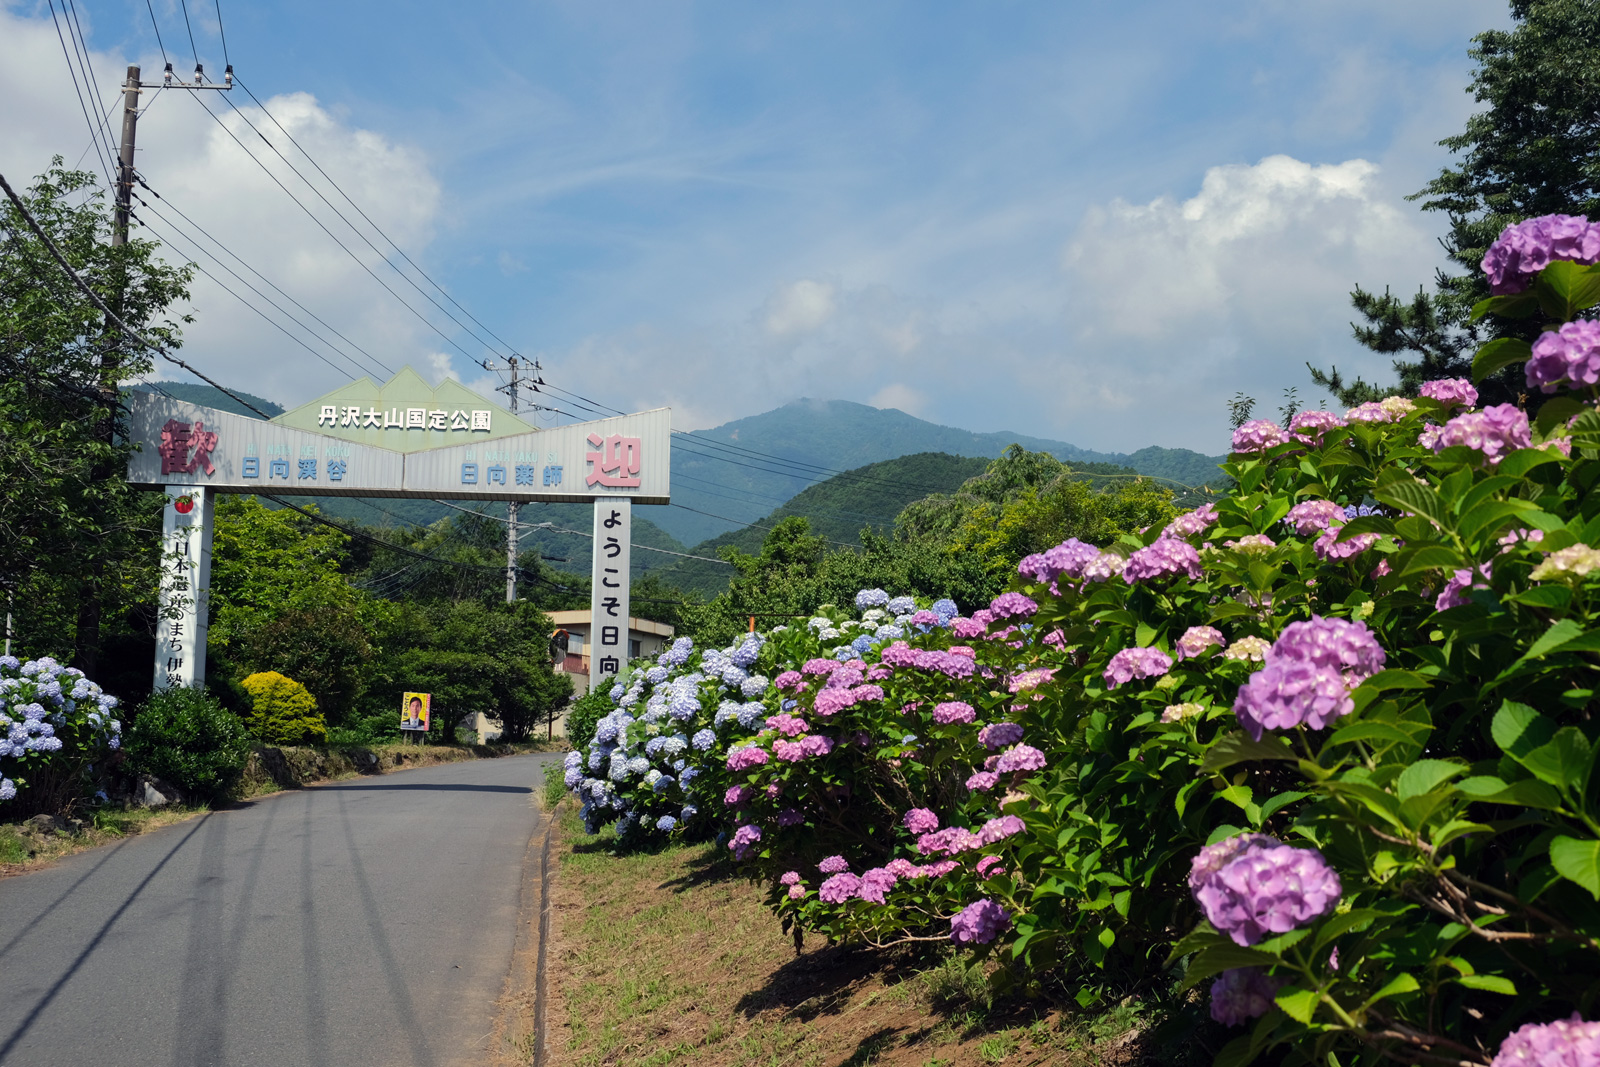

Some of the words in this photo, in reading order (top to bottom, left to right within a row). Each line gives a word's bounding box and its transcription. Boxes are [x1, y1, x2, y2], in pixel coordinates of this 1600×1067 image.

[318, 405, 492, 431] 丹沢大山国定公園
[267, 444, 292, 456] NATA
[466, 450, 476, 461] HI
[485, 450, 510, 462] NATA
[514, 451, 538, 463] YAKU
[547, 452, 558, 463] SI
[242, 457, 347, 480] 日向渓谷
[461, 463, 563, 486] 日向薬師
[600, 509, 622, 675] ようこそ日向
